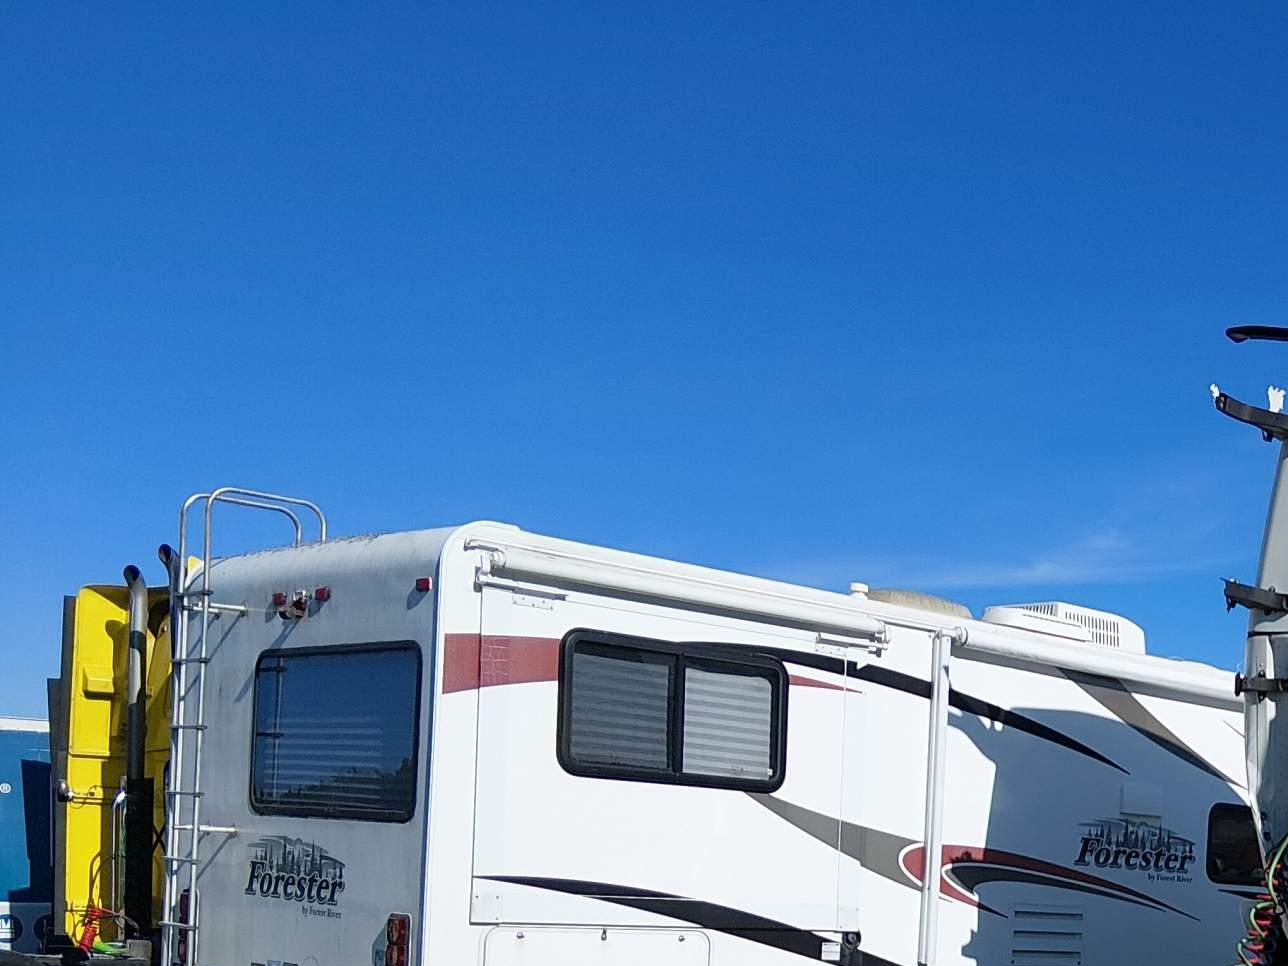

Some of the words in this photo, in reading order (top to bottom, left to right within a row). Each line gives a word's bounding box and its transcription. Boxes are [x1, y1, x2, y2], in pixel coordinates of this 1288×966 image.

[1074, 836, 1196, 873] Forester
[244, 860, 345, 905] Forester
[1147, 873, 1155, 883] by
[1156, 874, 1175, 882] Forest
[1177, 875, 1192, 884] River
[302, 905, 309, 917] by
[309, 906, 326, 917] Forest
[327, 908, 342, 919] River
